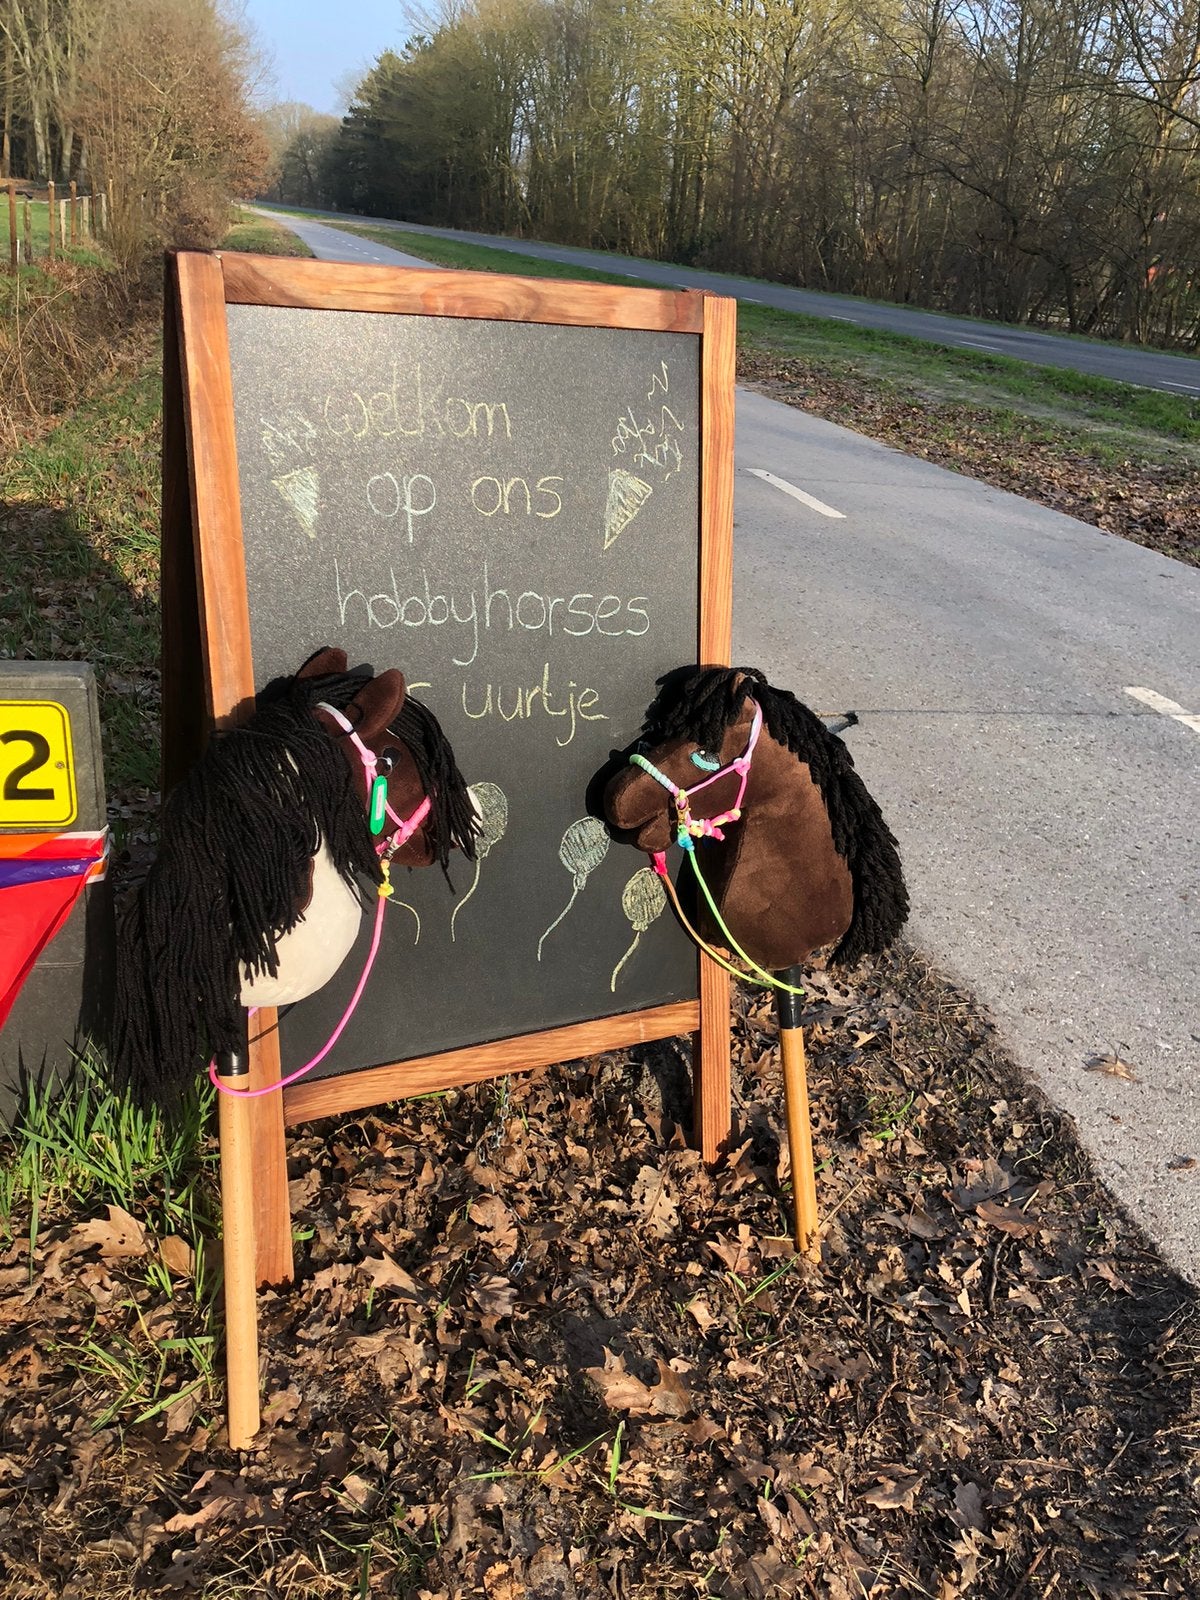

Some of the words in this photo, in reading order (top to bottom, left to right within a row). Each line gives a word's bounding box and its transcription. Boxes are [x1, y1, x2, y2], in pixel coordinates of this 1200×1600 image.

[365, 471, 437, 543] op
[470, 474, 565, 519] ons
[333, 557, 651, 666] hobbyhorses
[461, 662, 610, 747] uurtje
[0, 729, 55, 801] 2
